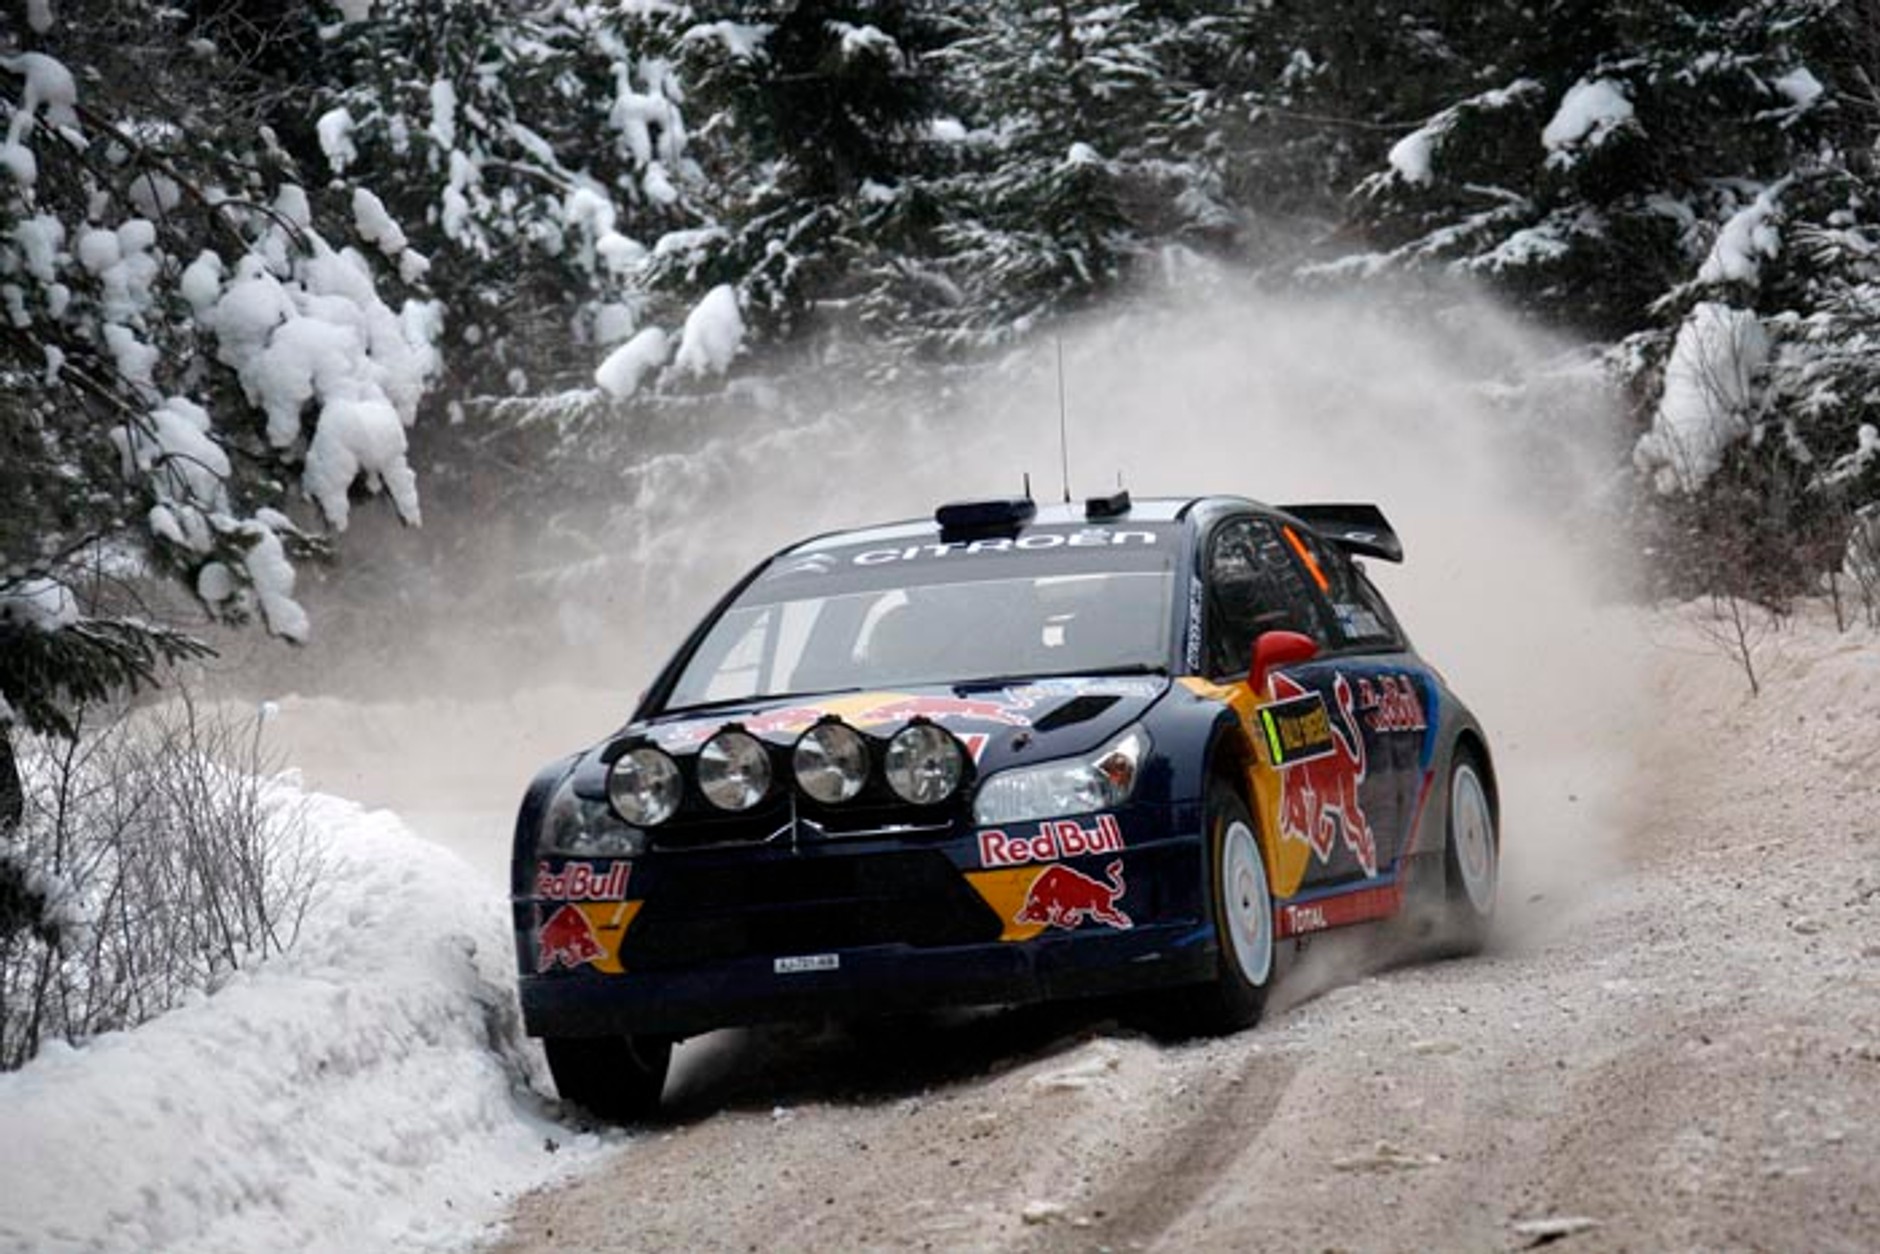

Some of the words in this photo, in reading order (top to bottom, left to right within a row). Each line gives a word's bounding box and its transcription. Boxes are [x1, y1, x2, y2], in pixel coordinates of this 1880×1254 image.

[978, 822, 1059, 868] Red
[1055, 814, 1124, 858] Bull
[567, 860, 632, 900] Bull
